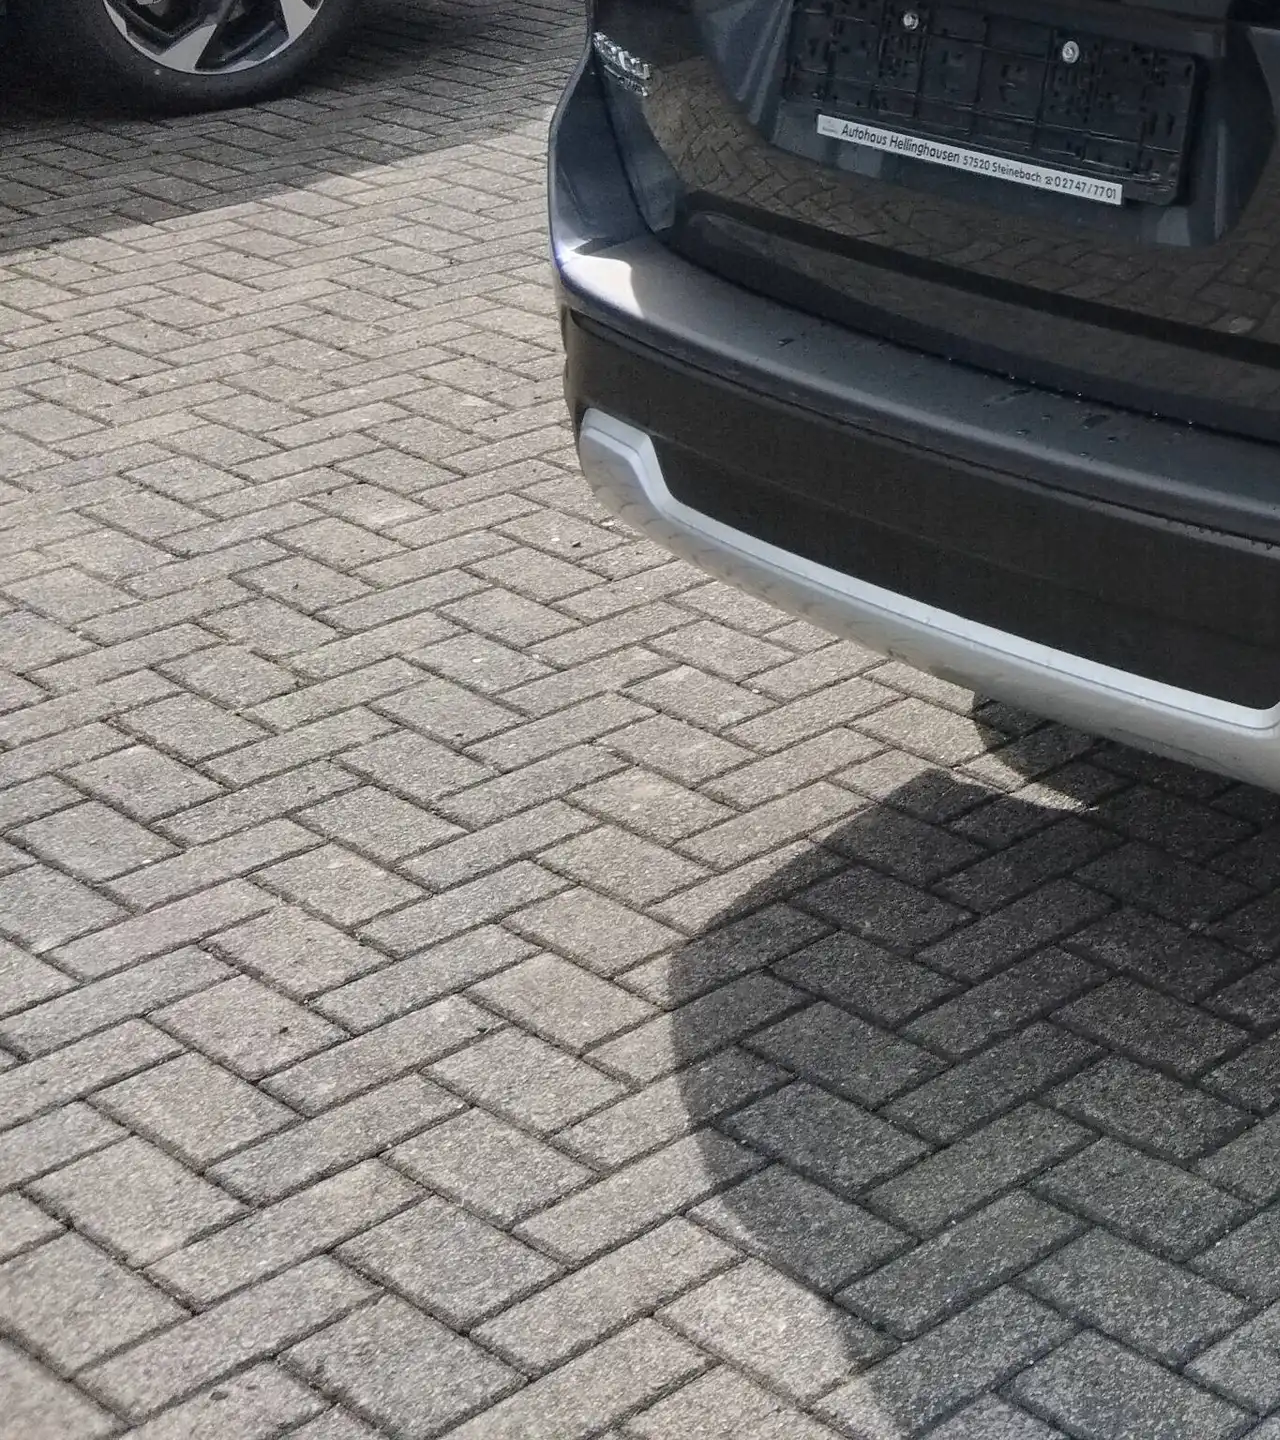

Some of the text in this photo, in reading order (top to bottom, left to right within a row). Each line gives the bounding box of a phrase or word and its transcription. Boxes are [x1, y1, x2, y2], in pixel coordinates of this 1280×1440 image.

[841, 123, 887, 146] Autohaus
[889, 134, 960, 163] Hellinghausen
[962, 154, 990, 171] 57520
[992, 161, 1042, 184] Steinebach
